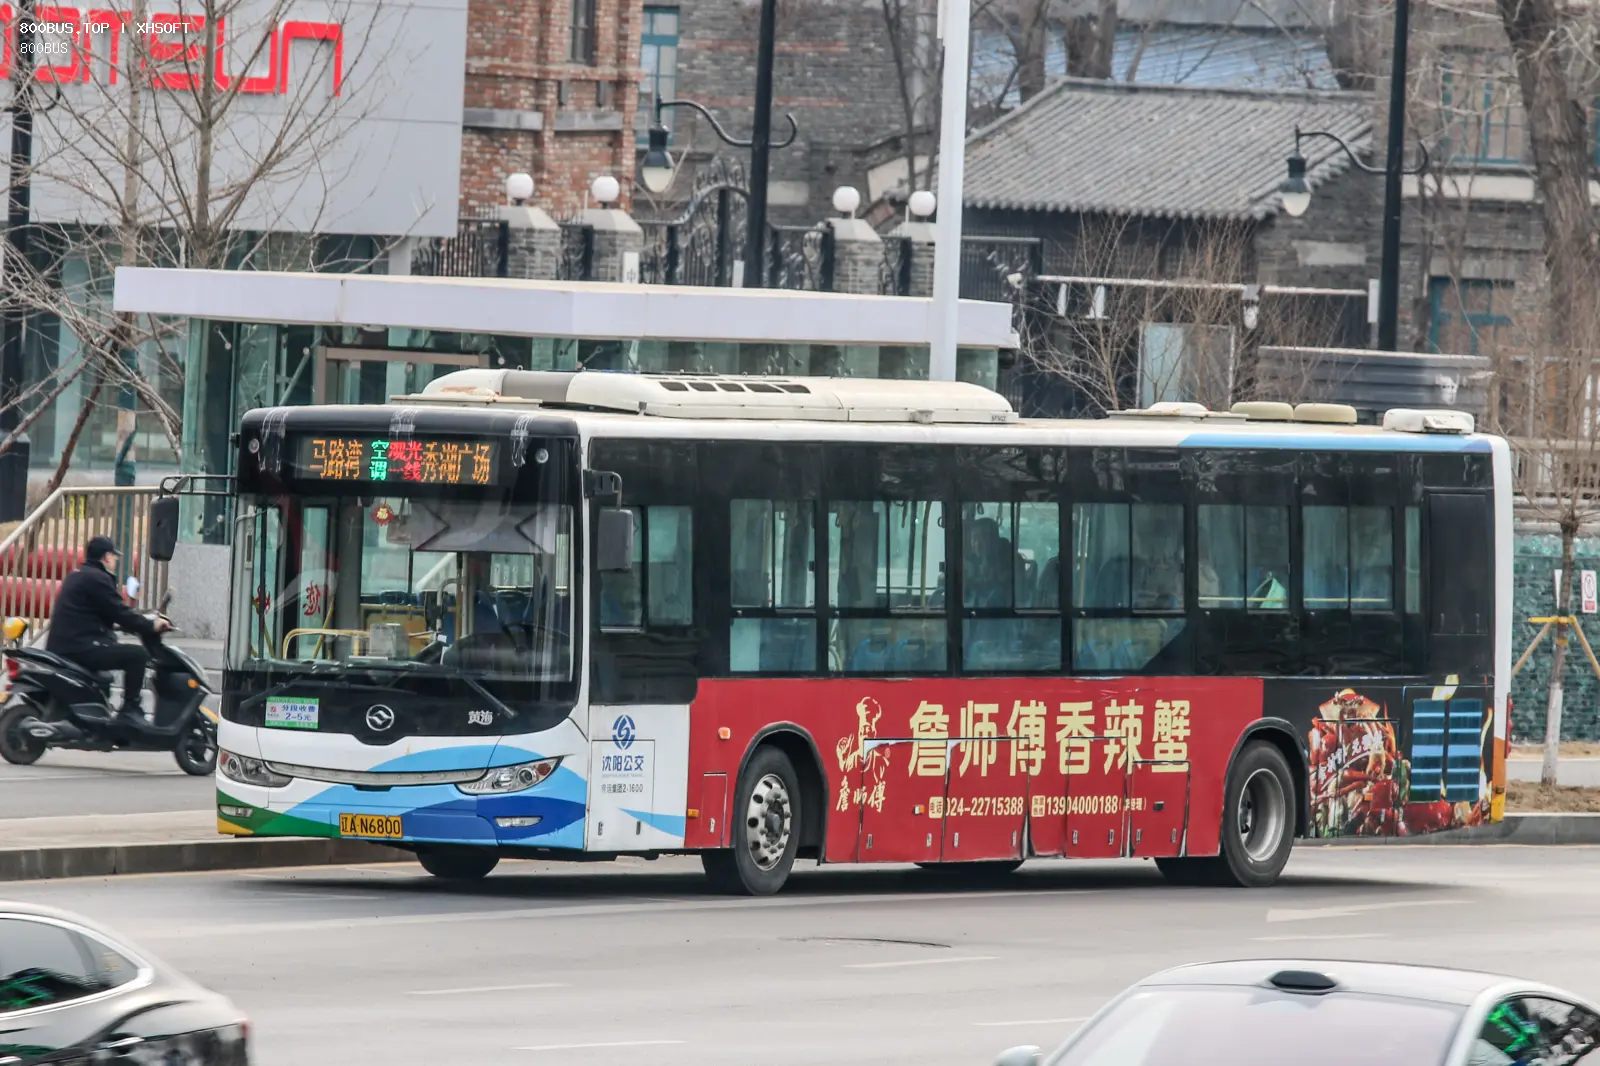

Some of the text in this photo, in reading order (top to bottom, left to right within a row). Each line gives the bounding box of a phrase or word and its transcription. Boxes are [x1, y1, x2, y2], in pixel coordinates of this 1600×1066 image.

[369, 439, 390, 481] 空调
[281, 703, 316, 713] 分段收费
[467, 709, 493, 726] 黄海
[907, 699, 1192, 778] 詹师傅香辣蟹
[602, 755, 644, 771] 沈阳公交
